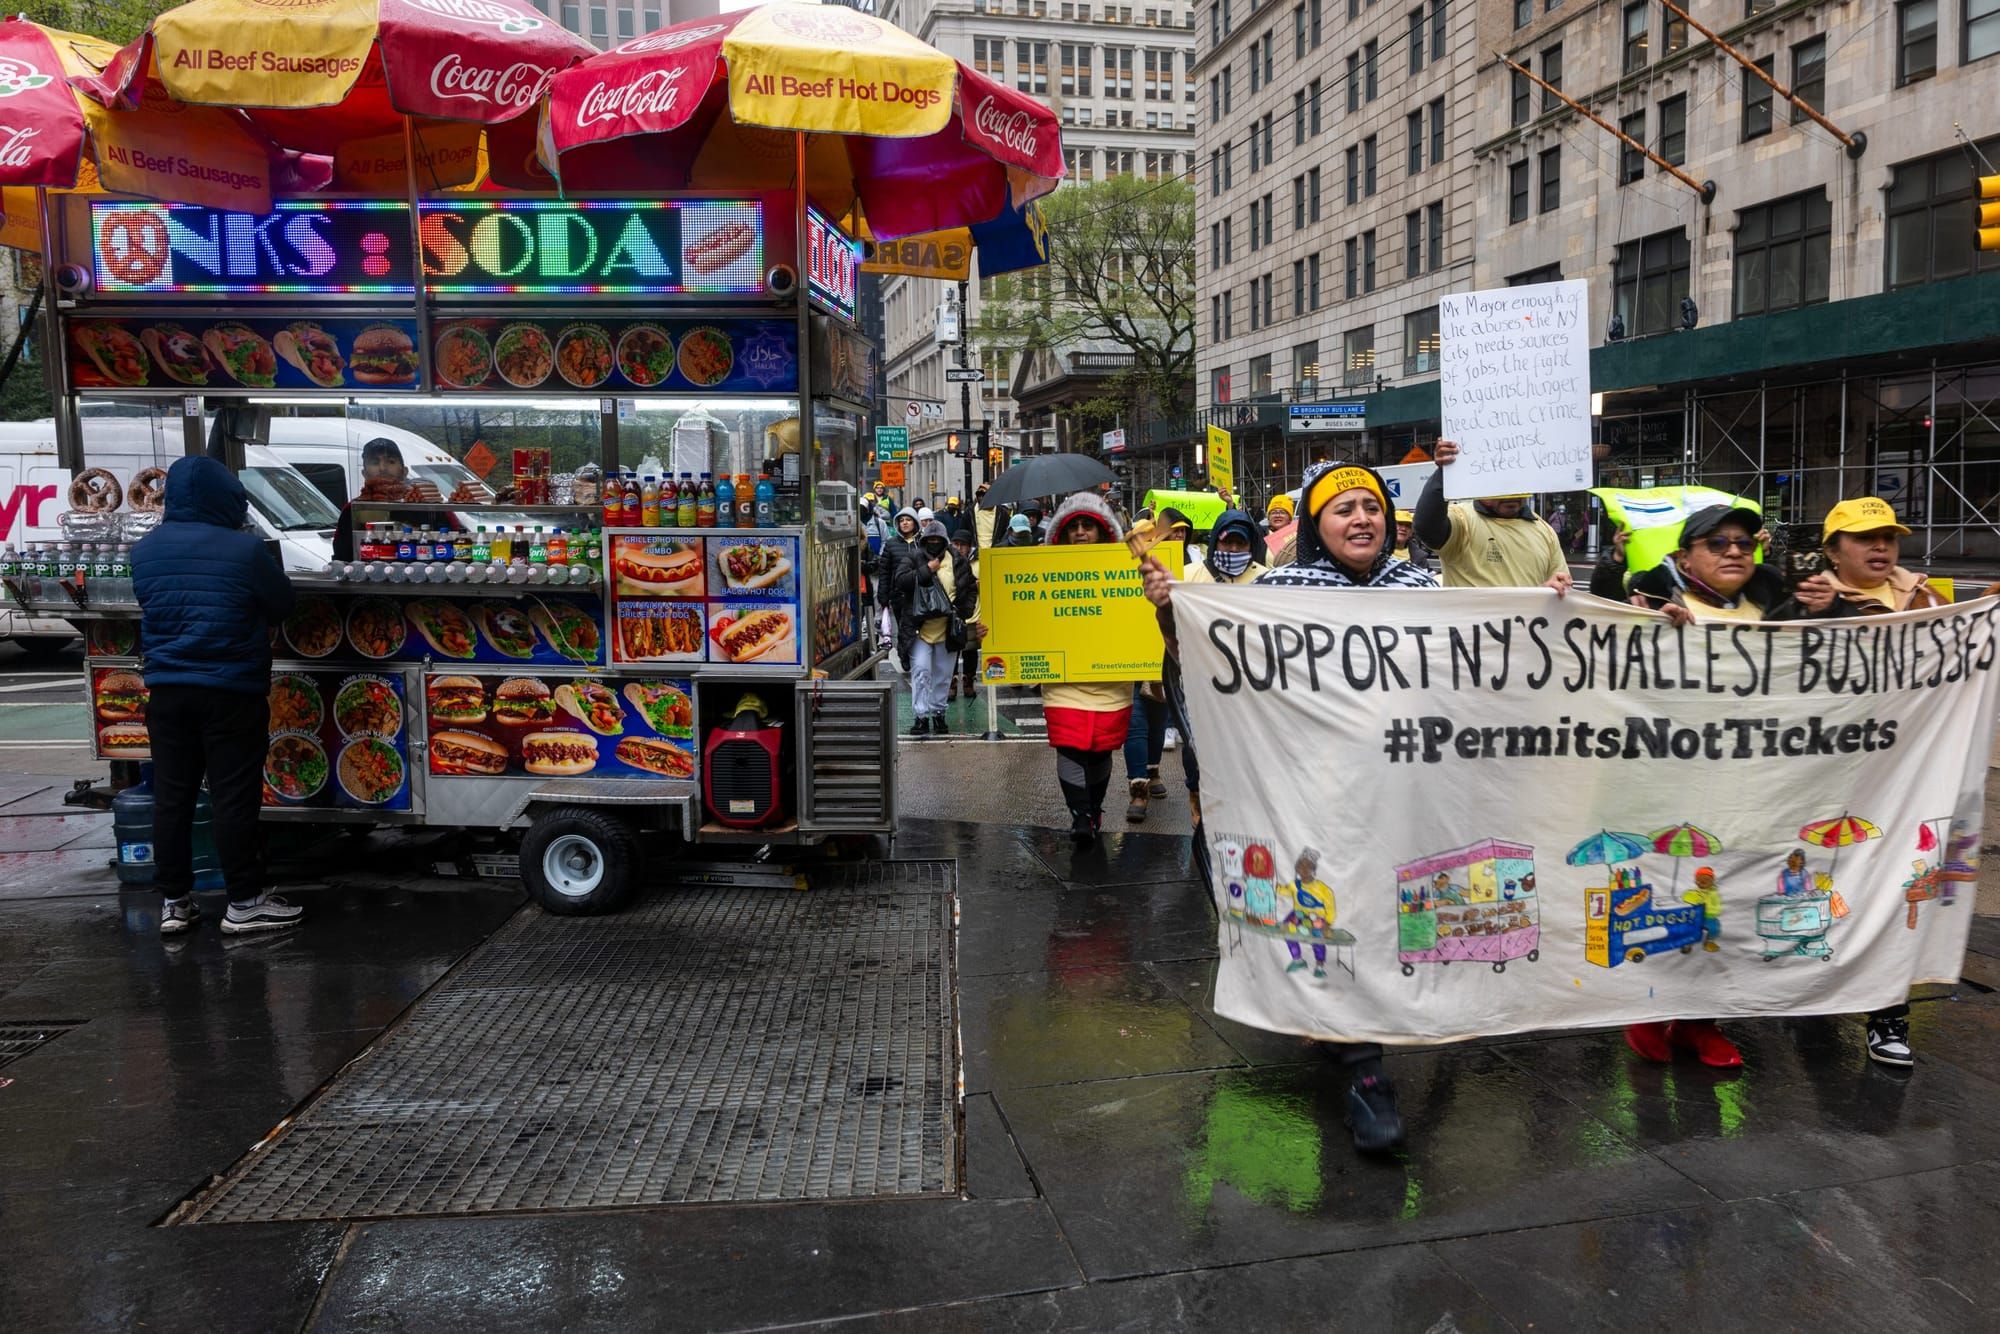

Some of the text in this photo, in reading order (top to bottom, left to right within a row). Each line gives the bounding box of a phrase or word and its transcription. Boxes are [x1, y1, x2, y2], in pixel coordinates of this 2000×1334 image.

[174, 50, 360, 79] All Beef Sausages
[577, 67, 689, 127] Coca-Cola
[745, 74, 941, 109] All Beef Hot Dogs
[974, 95, 1038, 158] Coca-Cola
[108, 144, 262, 190] All Beef Sausages
[419, 212, 673, 277] SODA
[1442, 301, 1459, 318] Mr
[1466, 296, 1509, 318] Mayor
[1511, 287, 1564, 314] enough
[1442, 321, 1466, 341] the
[1557, 308, 1578, 329] NY
[1475, 335, 1514, 355] needs
[1518, 333, 1569, 350] sources
[1442, 365, 1459, 386] of
[1503, 354, 1529, 375] the
[1533, 350, 1572, 378] fight
[1444, 411, 1484, 437] need
[1488, 405, 1523, 429] and
[1214, 435, 1224, 446] NYC
[720, 502, 729, 513] G
[740, 502, 750, 513] G
[759, 502, 768, 513] G
[624, 536, 695, 544] GRILLED HOT DOG
[1003, 573, 1038, 585] 11.926
[1042, 571, 1100, 583] VENDORS
[1012, 587, 1143, 601] FOR A GENERL VENDO
[672, 611, 689, 619] DOG
[1053, 606, 1102, 617] LICENSE
[1208, 602, 2000, 698] SUPPORT NY'S SMALLEST BUSINESSES
[1091, 661, 1162, 671] #StreetVendorRefor
[339, 673, 357, 687] LAMB
[378, 675, 395, 688] RICE
[1384, 715, 1899, 764] #PermitsNotTickets
[1613, 916, 1641, 932] HOT
